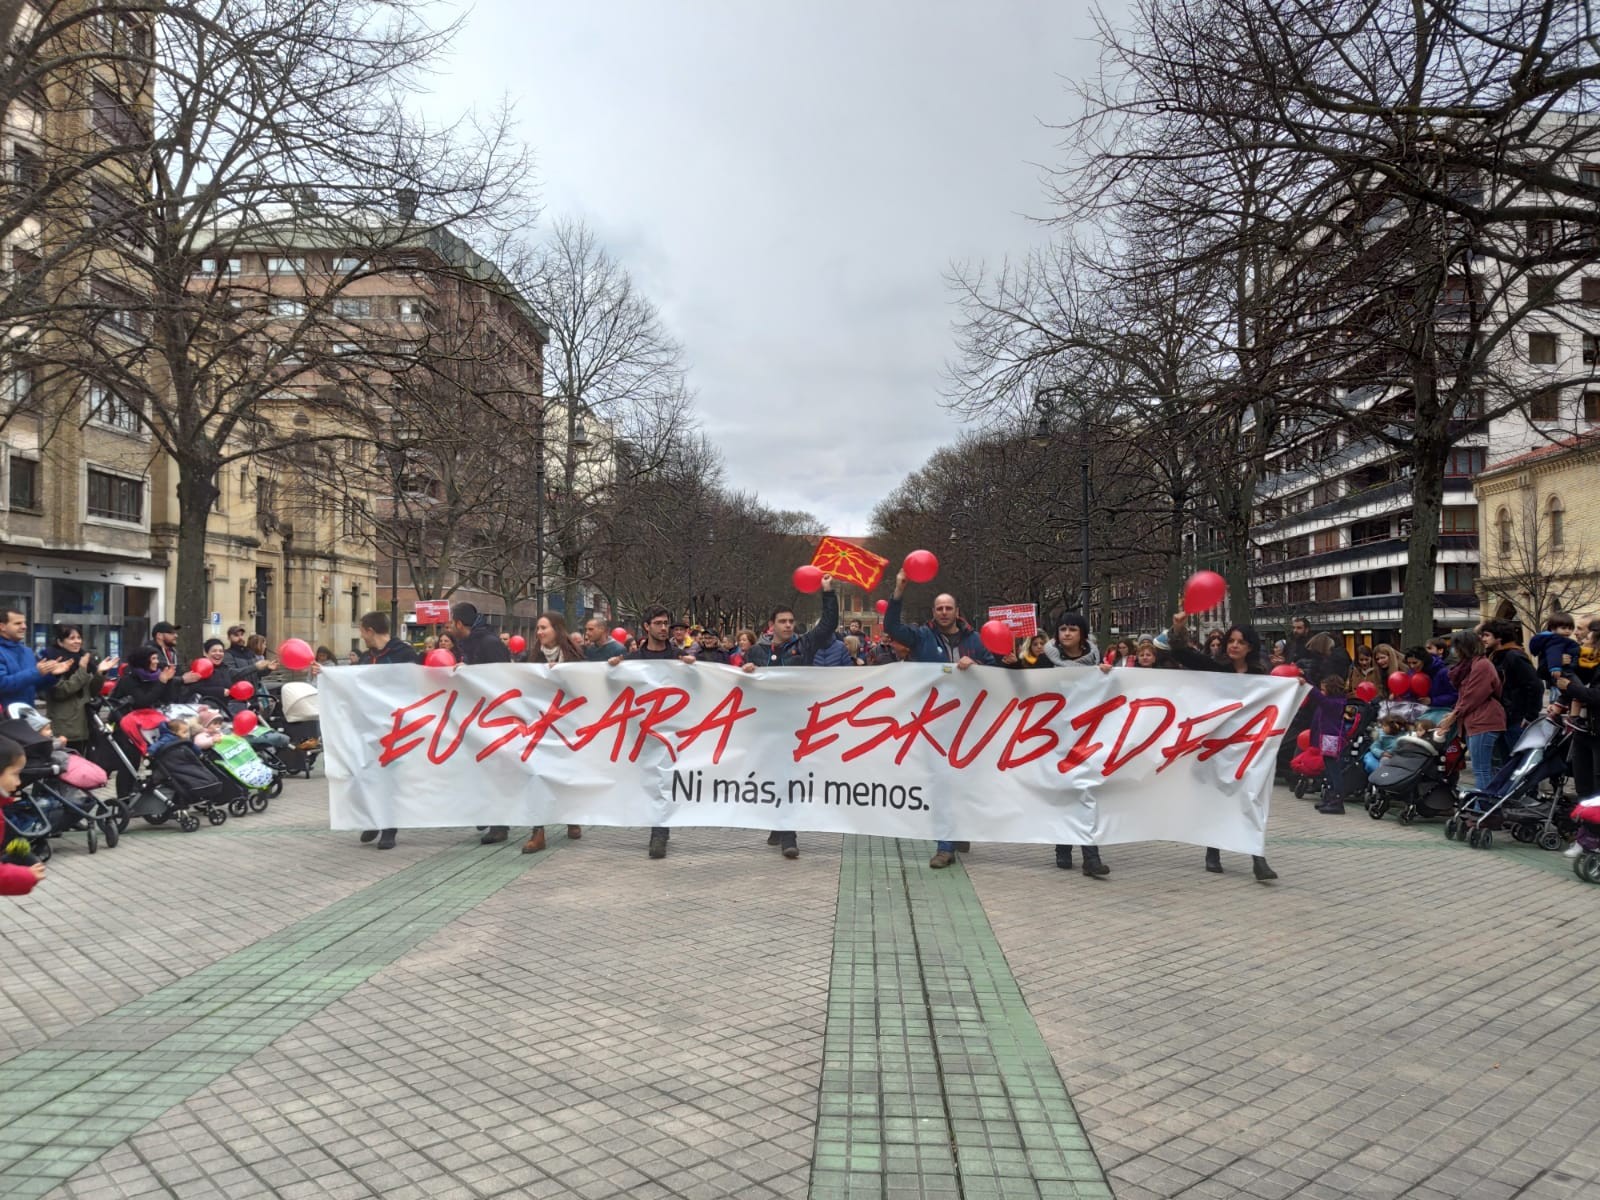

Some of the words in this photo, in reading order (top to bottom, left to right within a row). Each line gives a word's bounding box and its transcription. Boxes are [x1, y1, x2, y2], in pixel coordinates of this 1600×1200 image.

[378, 686, 757, 767] EUSKARA
[793, 686, 1286, 779] ESKUBIDEA
[672, 770, 702, 802] Ni
[713, 771, 782, 808] más,
[788, 772, 814, 804] ni
[824, 780, 930, 811] menos.
